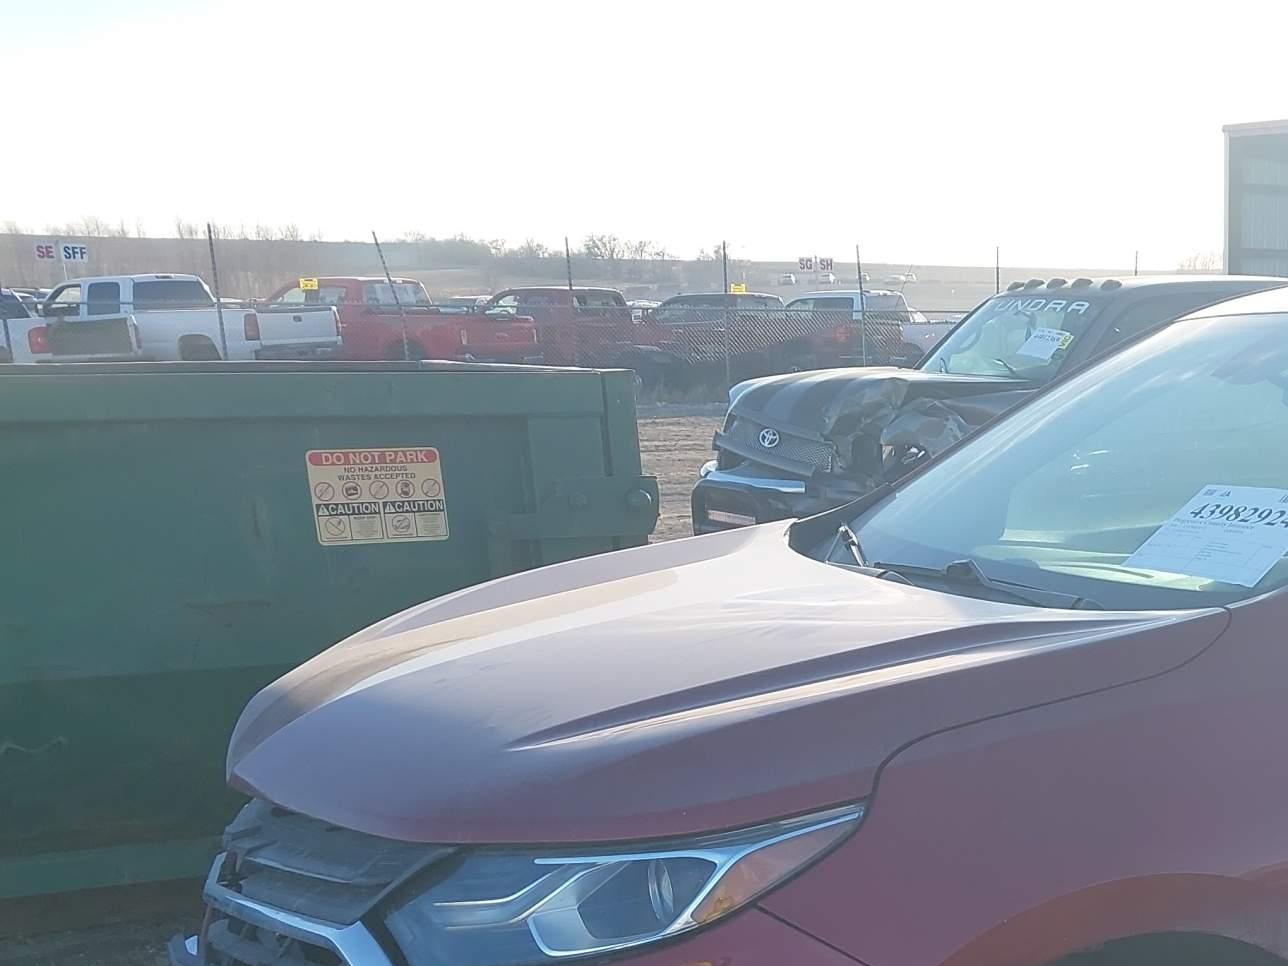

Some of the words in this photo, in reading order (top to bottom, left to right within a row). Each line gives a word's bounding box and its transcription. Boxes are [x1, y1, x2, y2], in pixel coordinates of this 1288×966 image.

[36, 244, 56, 260] SE
[63, 245, 88, 260] SFF
[798, 257, 813, 271] SG
[819, 257, 833, 271] SH
[321, 452, 345, 466] DO
[349, 451, 383, 465] NOT
[385, 450, 429, 463] PARK
[343, 466, 357, 474] NO
[358, 464, 409, 473] HAZARDOUS
[337, 473, 373, 481] WASTES
[373, 472, 417, 480] ACCEPTED
[328, 502, 380, 515] CAUTION
[394, 500, 444, 513] CAUTION
